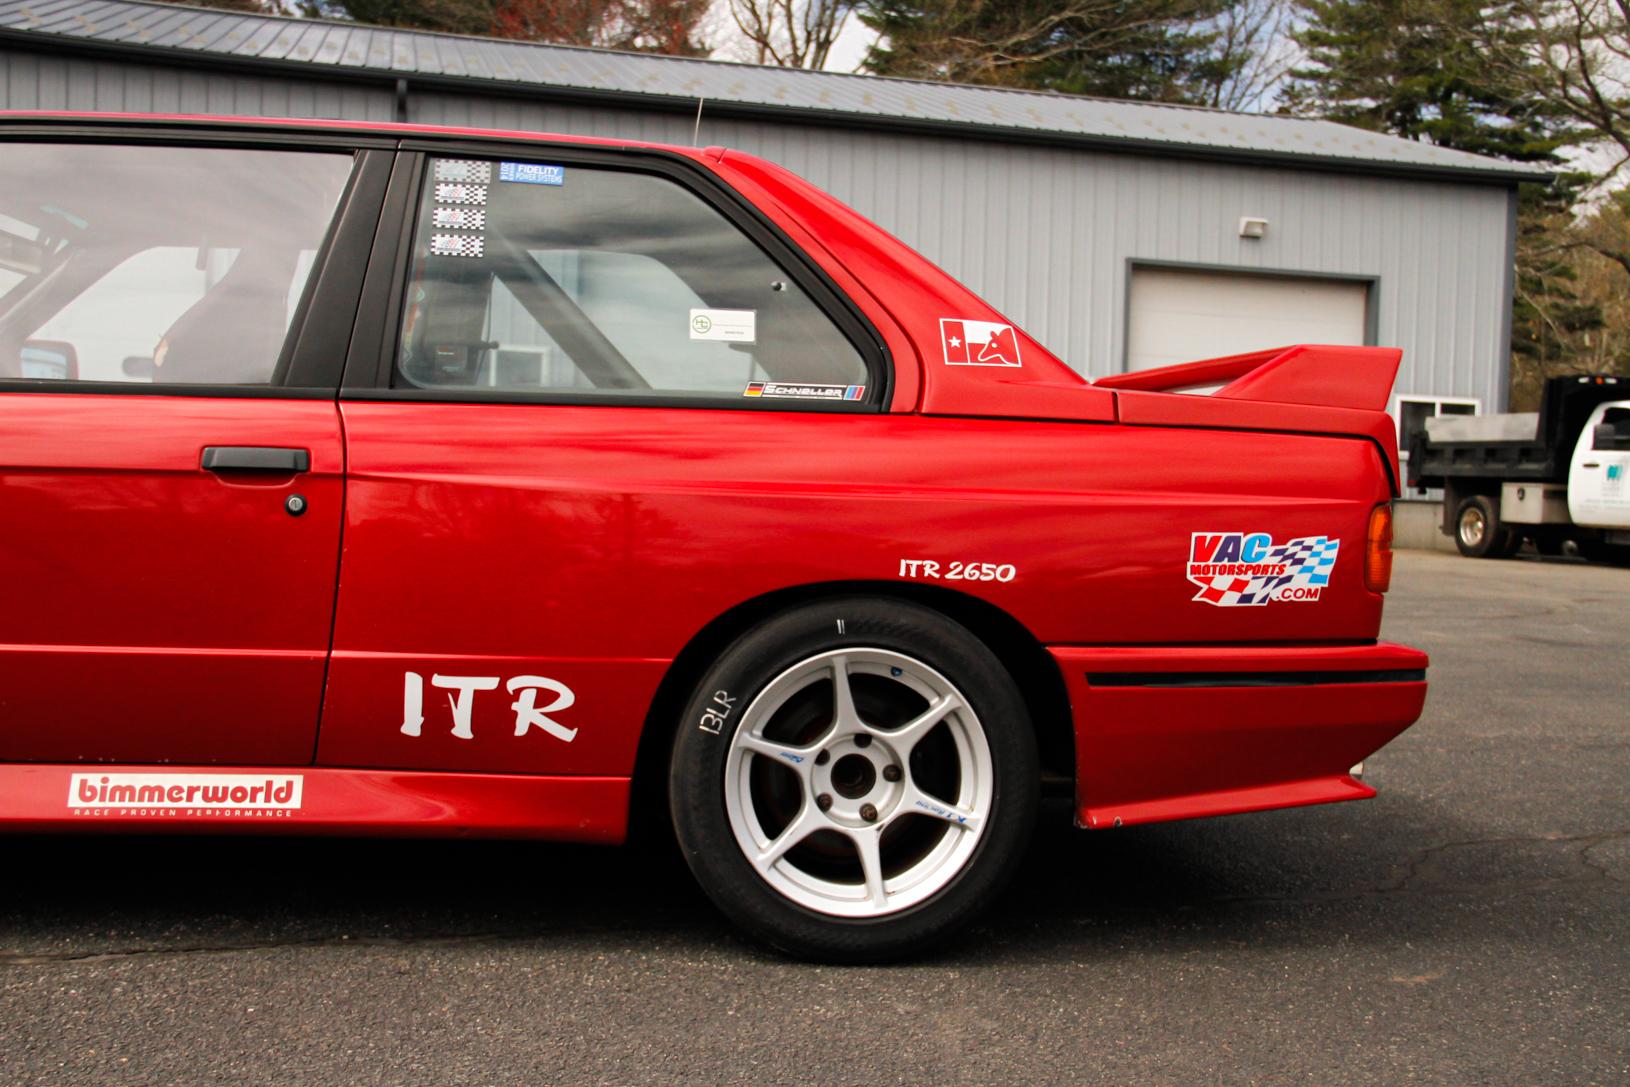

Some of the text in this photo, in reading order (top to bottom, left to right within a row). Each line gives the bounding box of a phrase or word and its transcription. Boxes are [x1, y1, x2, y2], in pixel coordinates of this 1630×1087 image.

[518, 165, 559, 175] FIDELITY
[1192, 535, 1271, 563] VAC
[898, 559, 1017, 583] ITR 2650
[1189, 563, 1287, 576] MOTORSPORTS
[1276, 587, 1320, 600] .COM
[400, 671, 578, 743] ITR
[78, 776, 294, 804] bimmerworld
[120, 809, 177, 817] PROVEN
[186, 809, 293, 817] PERFORMANCE
